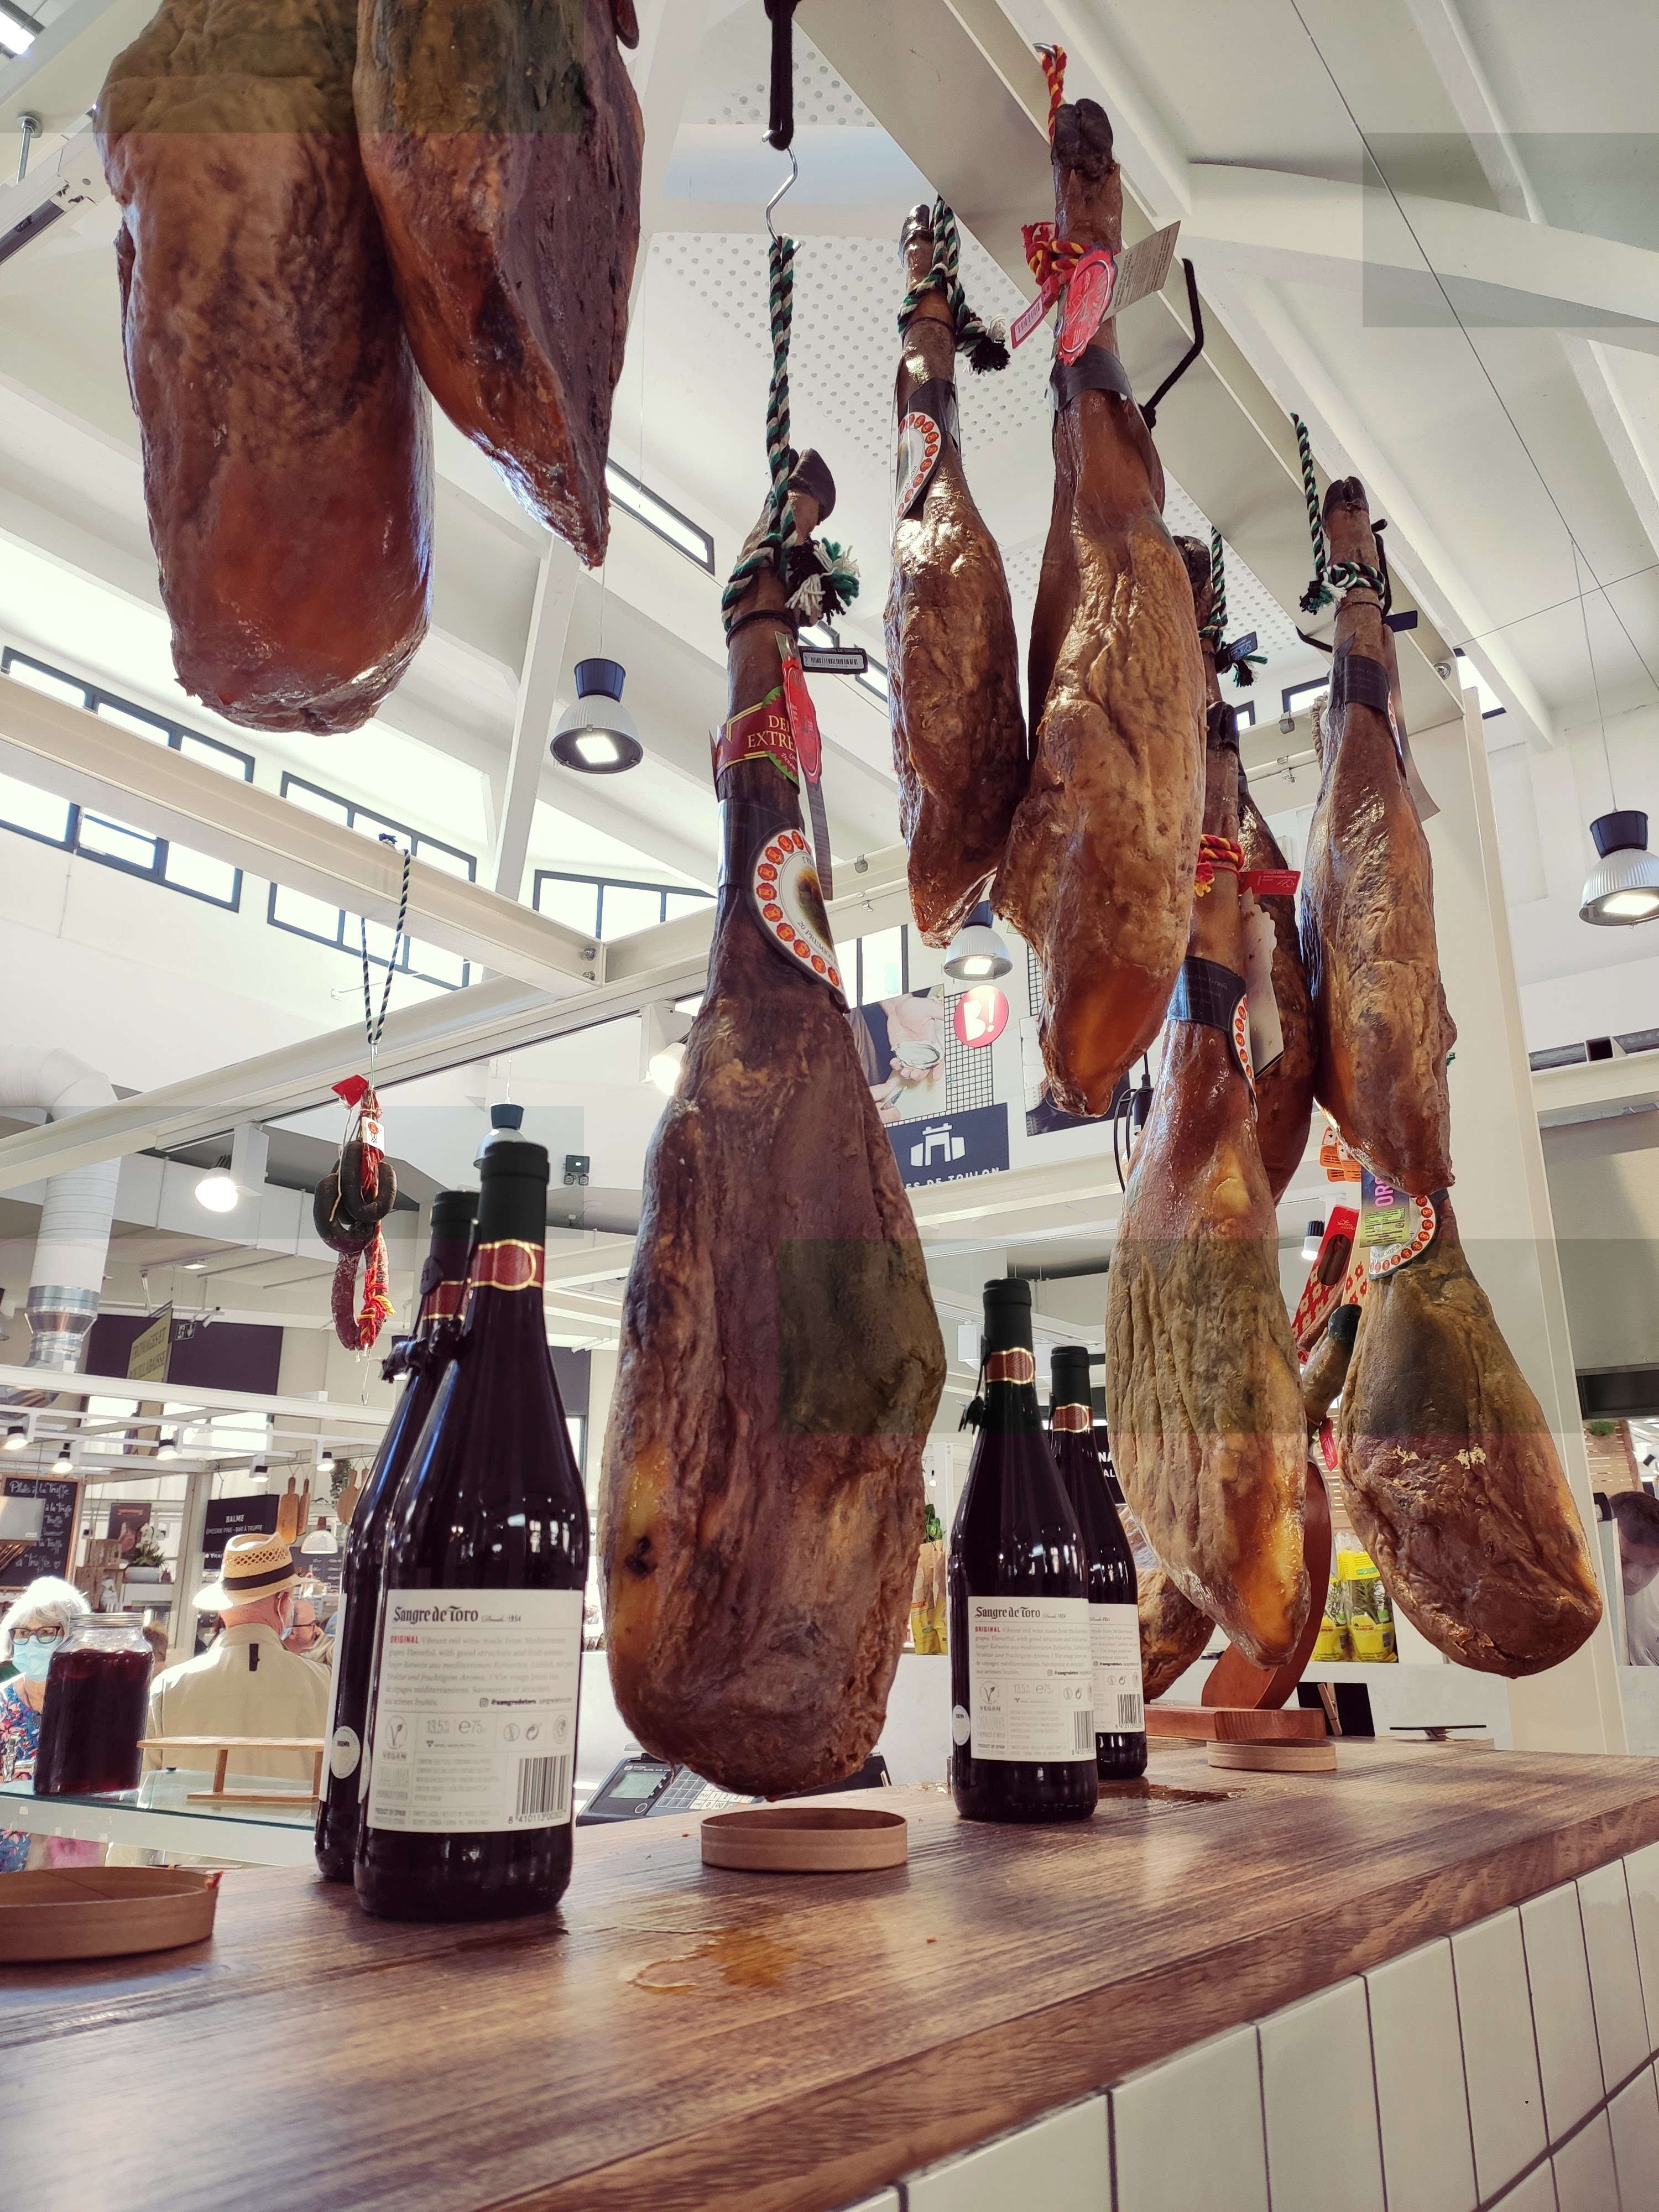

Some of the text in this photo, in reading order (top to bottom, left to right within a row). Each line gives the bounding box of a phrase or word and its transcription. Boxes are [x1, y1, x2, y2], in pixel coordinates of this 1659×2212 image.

[747, 730, 796, 753] EXTRE
[797, 920, 833, 961] 20 PREMIOS
[1386, 1244, 1400, 1255] MEJOR
[225, 1514, 244, 1524] BALME
[393, 1606, 431, 1625] Sangre
[432, 1606, 447, 1622] de
[447, 1605, 478, 1622] Toro
[974, 1606, 1008, 1620] Sangre
[1008, 1606, 1019, 1618] de
[1019, 1606, 1041, 1618] Toro
[390, 1635, 419, 1644] ORIGINAL
